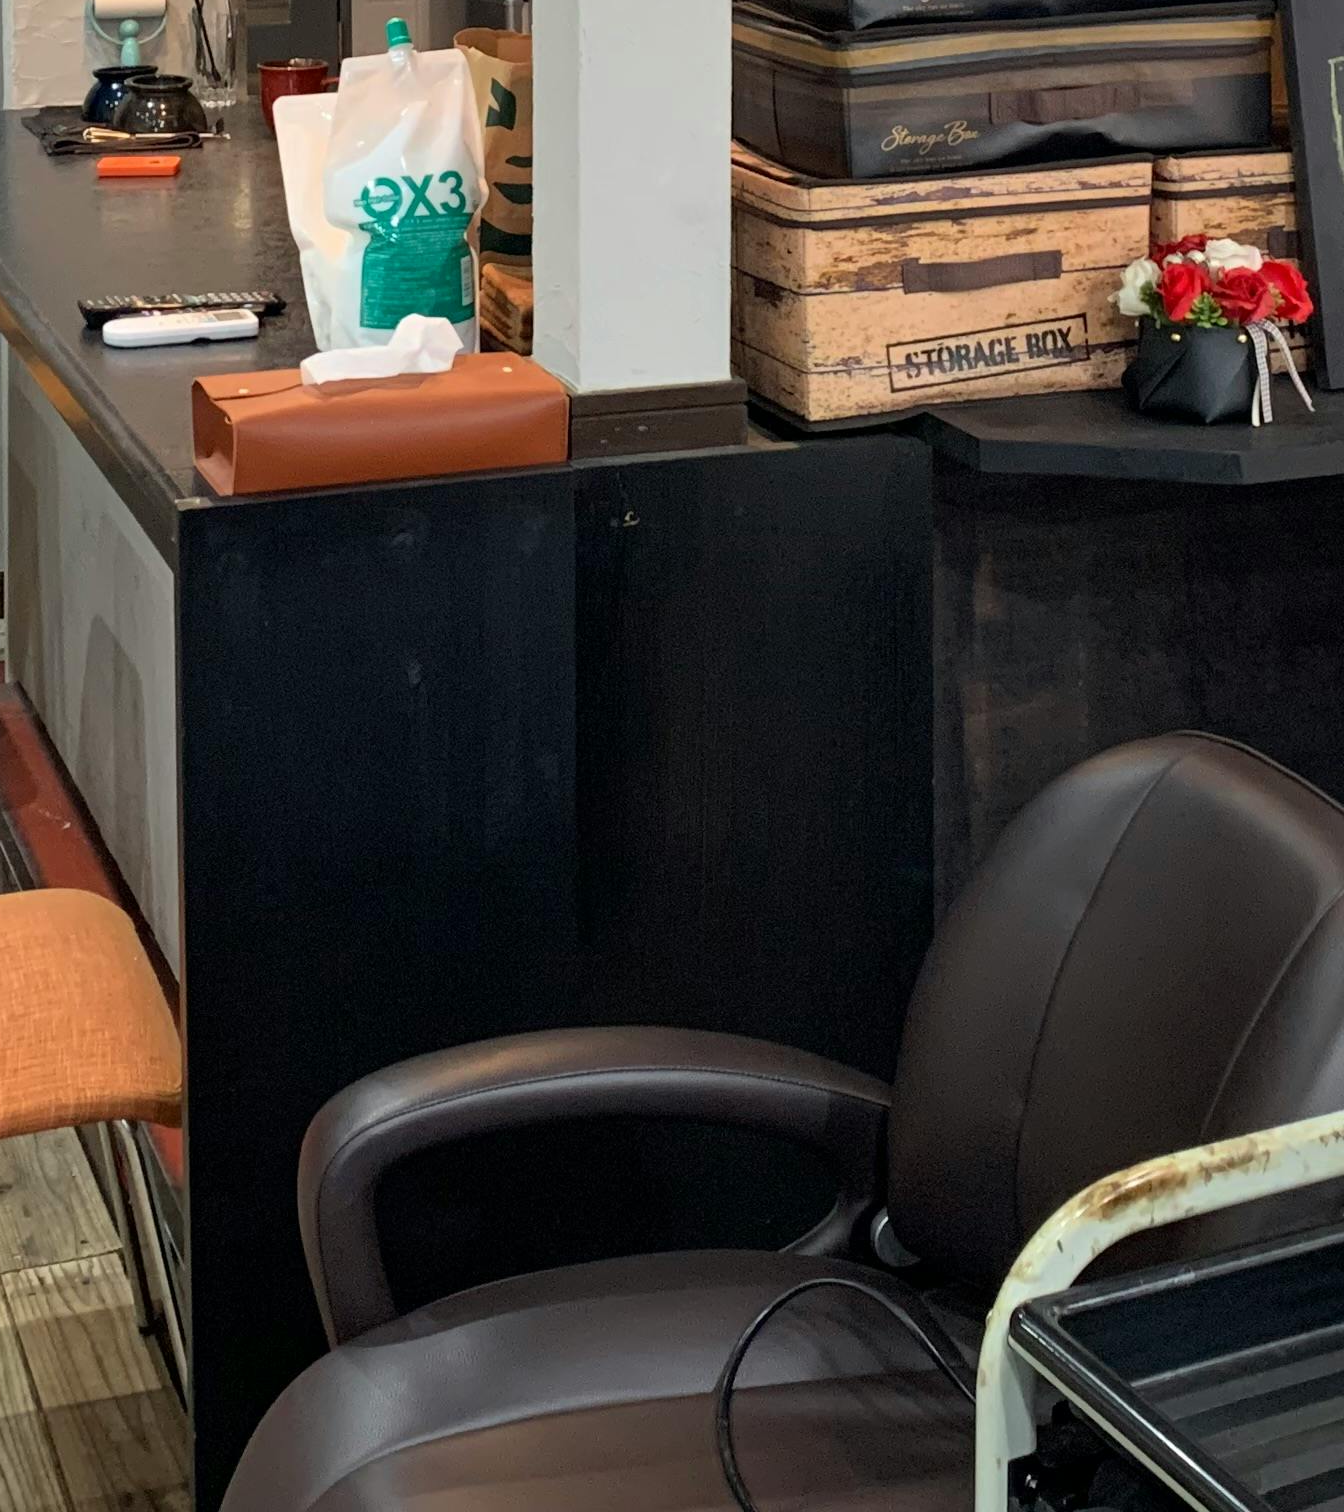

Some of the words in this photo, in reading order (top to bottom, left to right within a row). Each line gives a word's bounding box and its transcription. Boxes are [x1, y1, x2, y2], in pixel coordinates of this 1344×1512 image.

[880, 125, 946, 155] Storage
[943, 120, 981, 146] Box
[905, 336, 1020, 379] STORAGE
[1025, 326, 1073, 360] BOX
